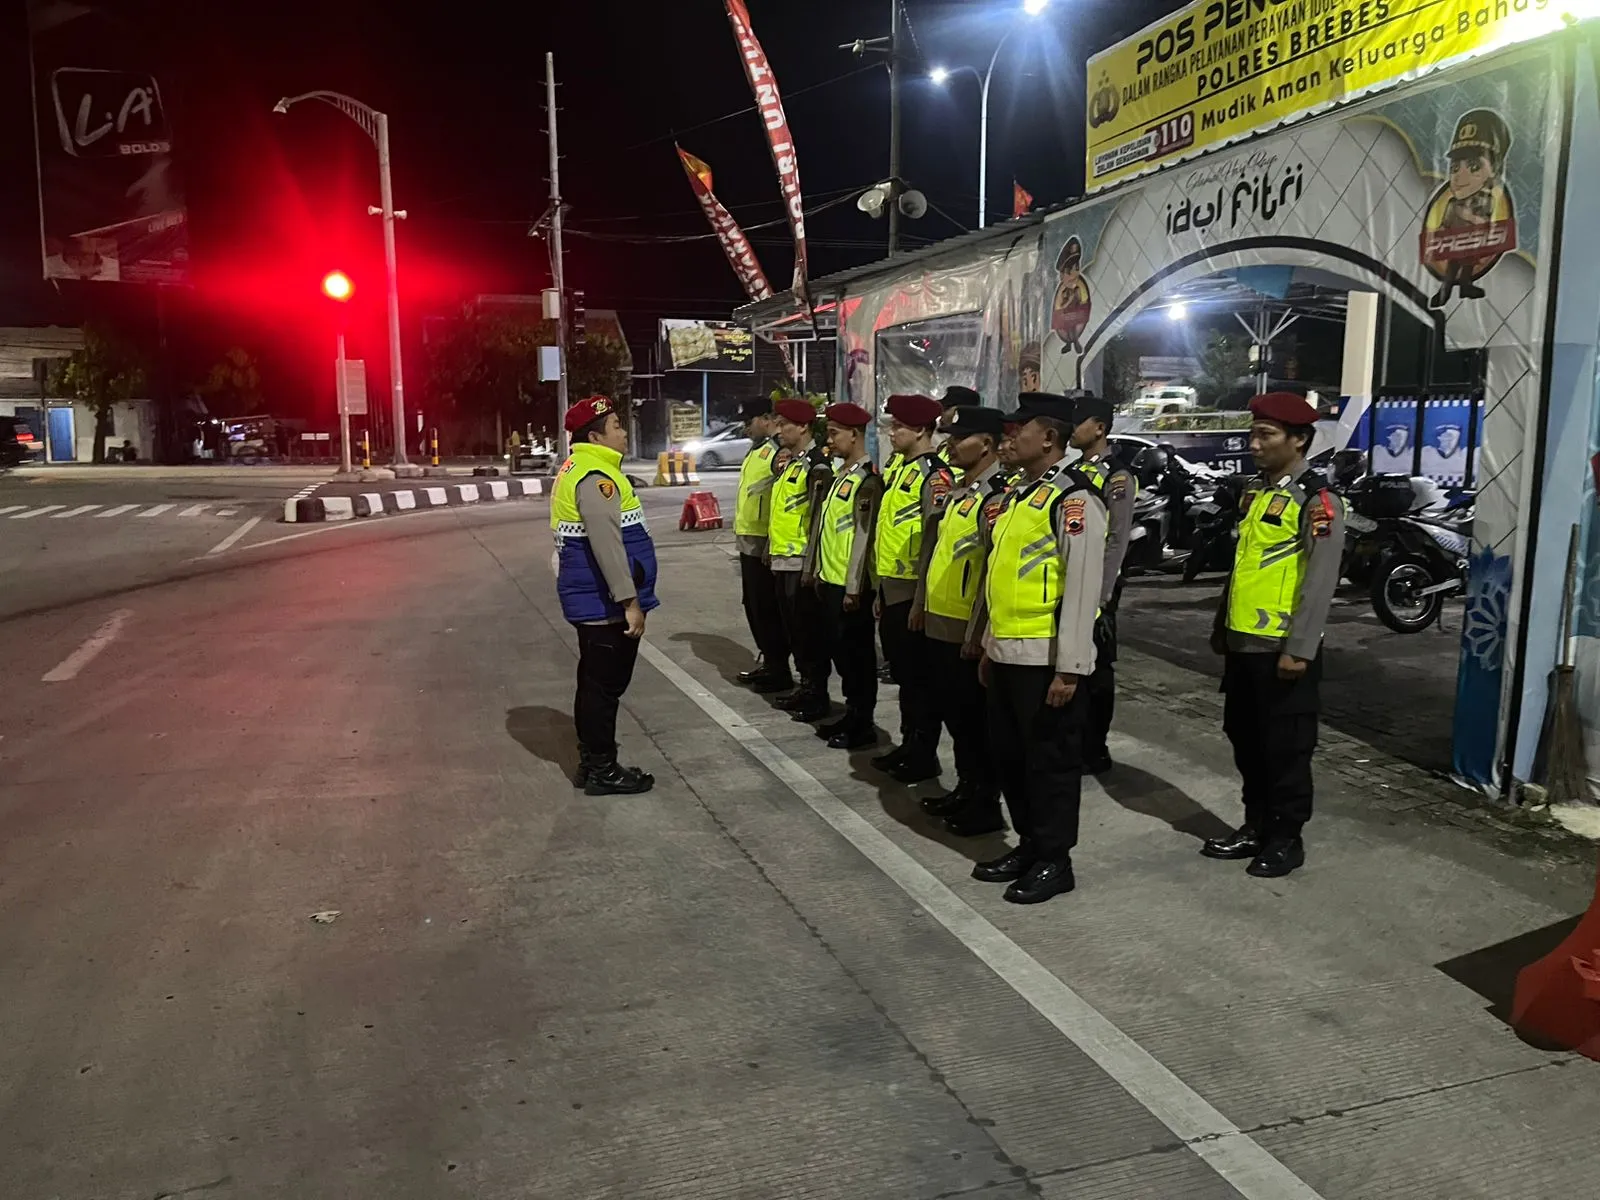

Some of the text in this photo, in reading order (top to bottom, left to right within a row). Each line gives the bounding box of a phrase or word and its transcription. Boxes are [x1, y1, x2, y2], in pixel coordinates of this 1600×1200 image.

[1122, 80, 1151, 106] DALAM
[1153, 61, 1187, 92] RANGKA
[1190, 29, 1245, 73] PELAYANAN
[1247, 2, 1305, 46] PERAYAAN
[1136, 0, 1288, 74] POS PEN
[1197, 0, 1389, 96] POLRES BREBES
[1201, 95, 1256, 131] Mudik
[1262, 70, 1321, 107] Aman
[1329, 24, 1445, 80] Keluarga
[1160, 114, 1192, 146] 110
